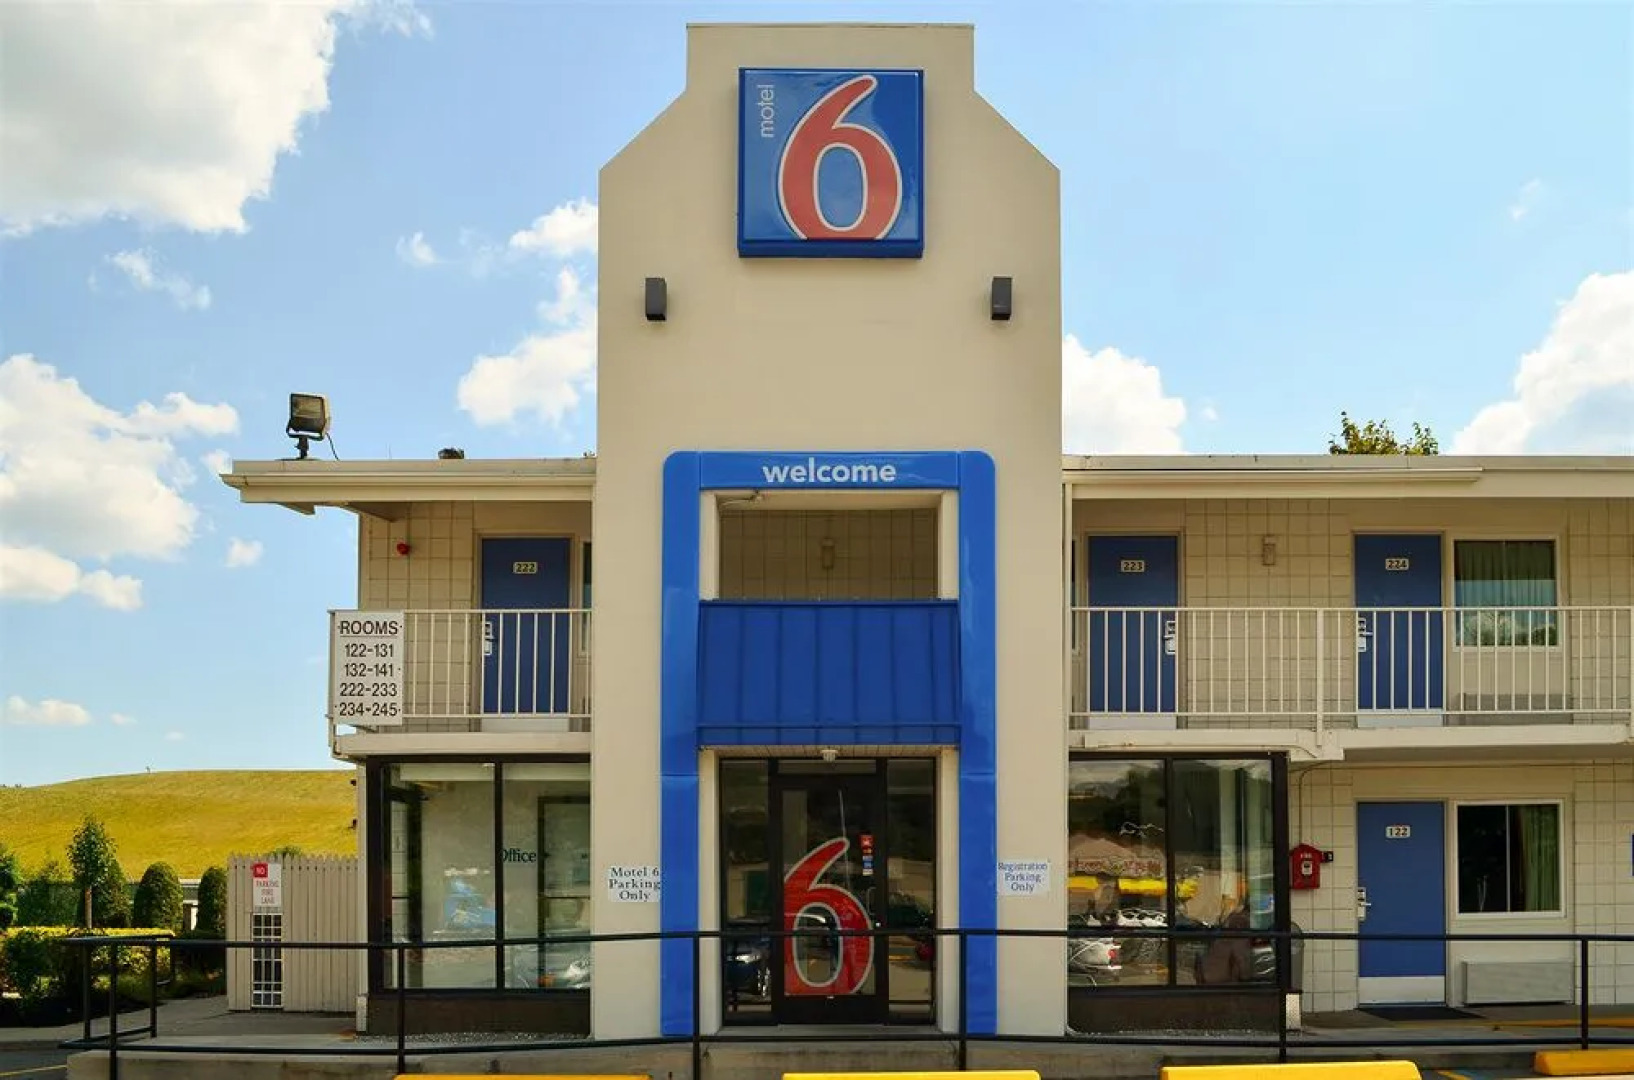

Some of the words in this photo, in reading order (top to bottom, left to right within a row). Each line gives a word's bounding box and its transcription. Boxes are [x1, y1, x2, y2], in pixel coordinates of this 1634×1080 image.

[757, 84, 774, 138] motel
[778, 75, 902, 239] 6
[763, 457, 896, 483] welcome
[516, 563, 535, 573] 222
[1123, 561, 1143, 571] 223
[1388, 560, 1407, 569] 224
[340, 620, 398, 634] ROOMS
[345, 643, 394, 657] 122-131
[345, 663, 394, 677] 132-141
[340, 682, 397, 697] 222-233
[340, 702, 397, 716] 234-245
[1389, 827, 1408, 836] 122
[611, 867, 648, 877] Motel
[652, 867, 659, 876] 6
[998, 862, 1047, 870] Registration
[1005, 873, 1041, 883] Parking
[609, 879, 660, 891] Parking
[1011, 882, 1035, 894] Only
[619, 890, 651, 902] Only
[784, 837, 874, 996] 6
